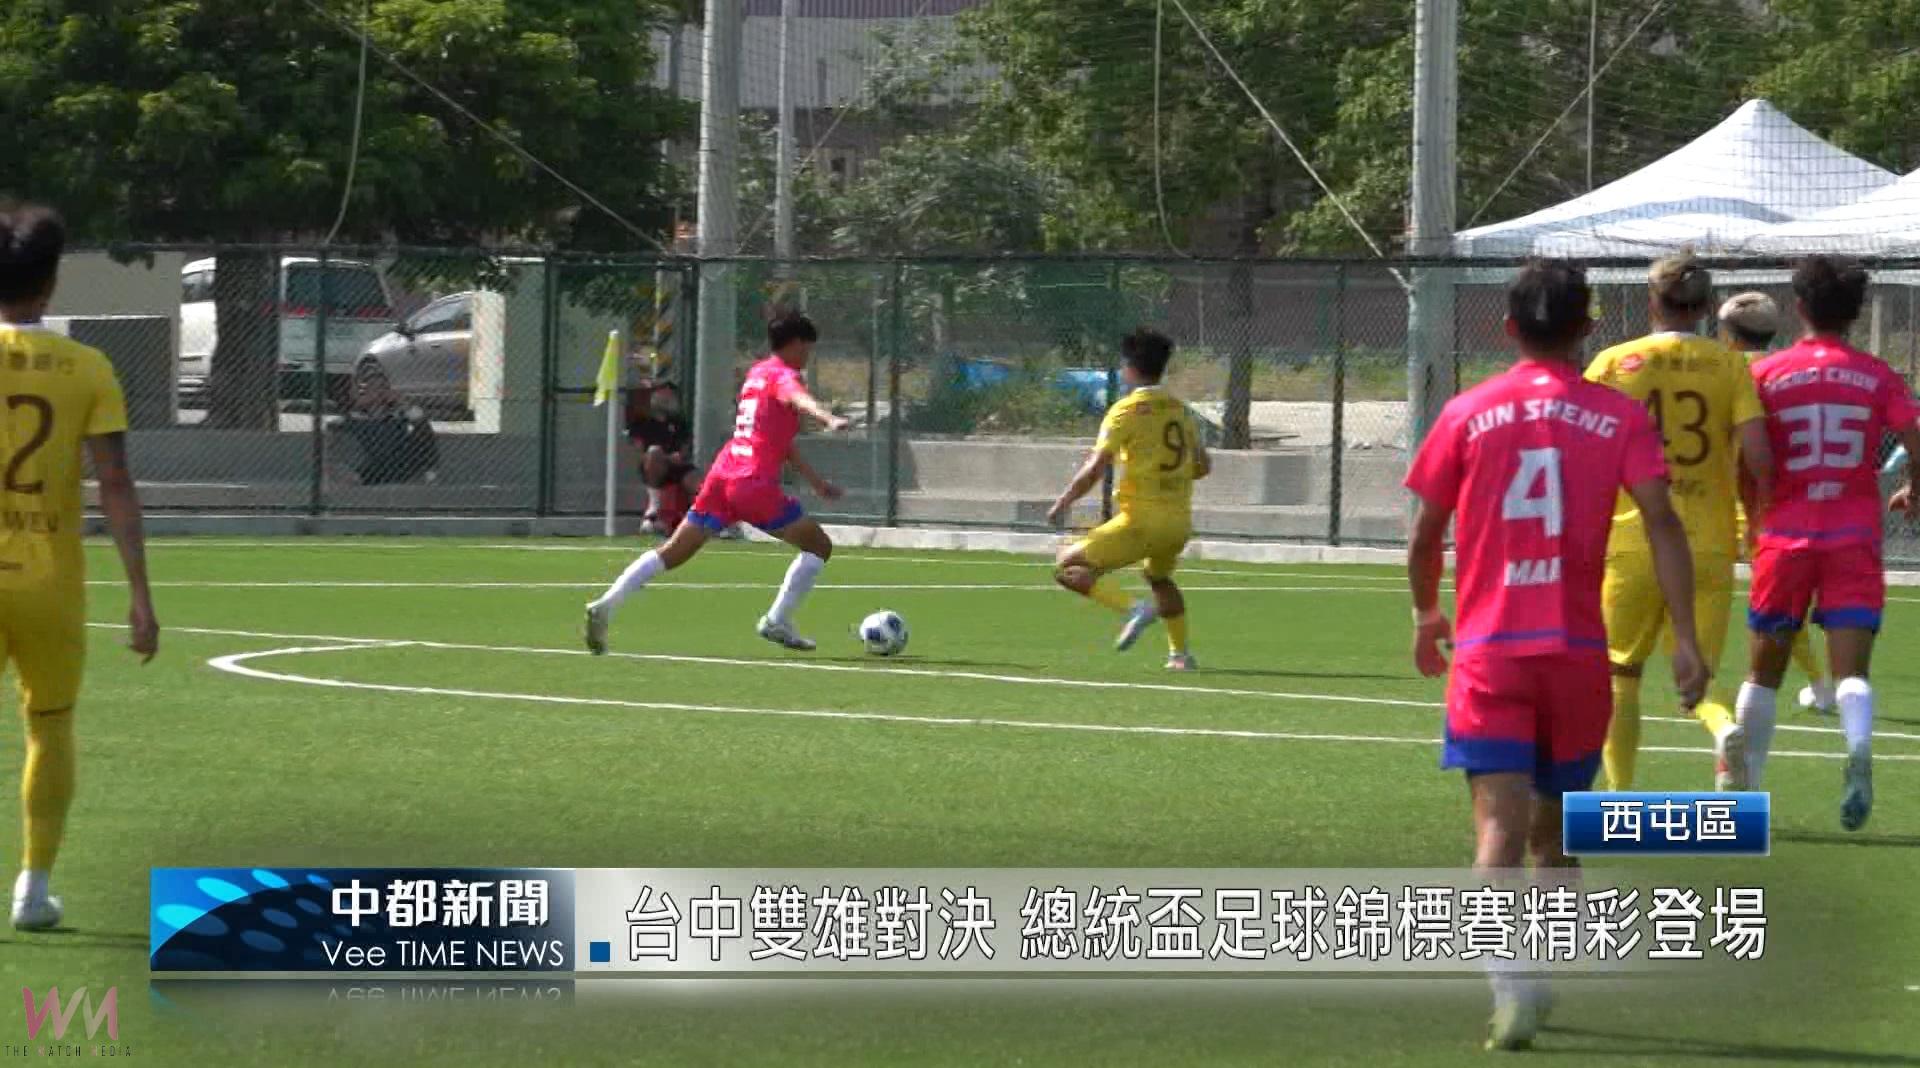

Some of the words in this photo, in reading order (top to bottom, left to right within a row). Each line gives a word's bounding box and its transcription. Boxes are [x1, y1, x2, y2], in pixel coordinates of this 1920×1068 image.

[1157, 420, 1186, 472] 9
[1466, 402, 1517, 443] JUN
[1523, 399, 1622, 438] SHENG
[1778, 403, 1872, 471] 35
[1502, 447, 1562, 538] 4
